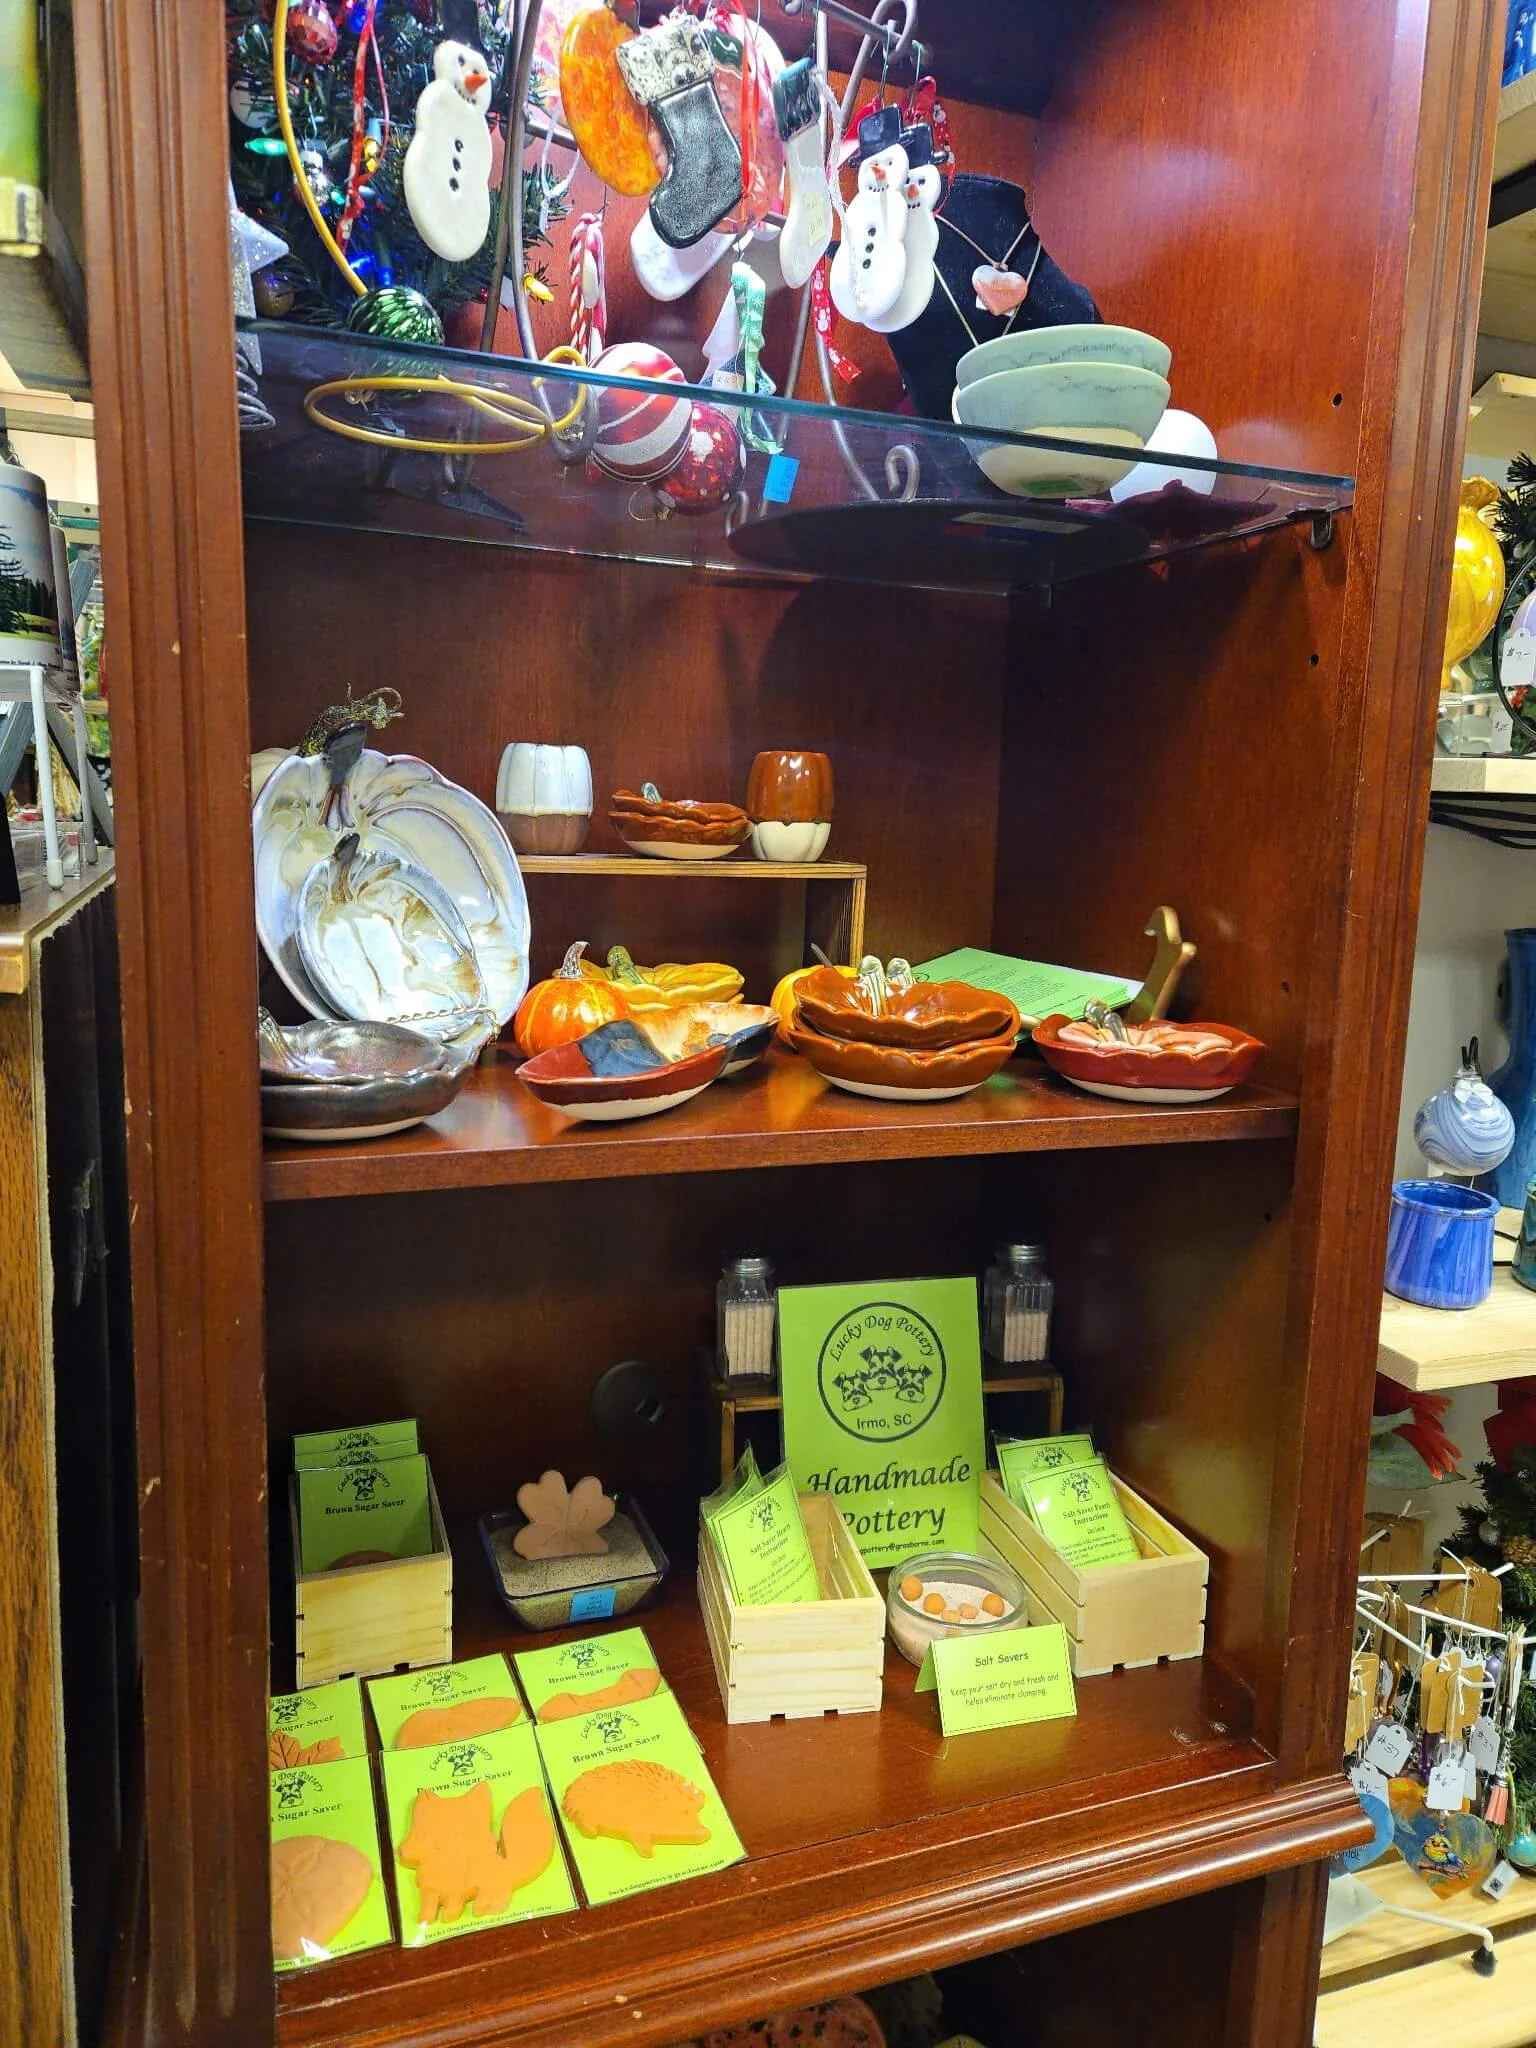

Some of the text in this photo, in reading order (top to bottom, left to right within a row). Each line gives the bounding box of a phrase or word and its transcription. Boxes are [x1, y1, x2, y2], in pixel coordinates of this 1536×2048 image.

[829, 1315, 934, 1363] Lucky Dog Pottery
[857, 1414, 912, 1431] Irmo, SC
[338, 1467, 391, 1492] Lucky Dog Pottery
[807, 1455, 971, 1495] Handmade
[325, 1499, 405, 1514] Brown Sugar Saver
[842, 1507, 946, 1536] Pottery
[975, 1652, 1029, 1667] Salt Savers
[548, 1661, 630, 1685] Brown Sugar Saver
[950, 1688, 967, 1697] Keep
[985, 1683, 998, 1691] salt
[999, 1680, 1012, 1688] dry
[1013, 1677, 1025, 1686] and
[1026, 1674, 1045, 1685] fresh
[1047, 1672, 1059, 1681] and
[400, 1685, 488, 1711] Brown Sugar Saver
[965, 1697, 983, 1706] helps
[985, 1692, 1016, 1703] eliminate
[306, 1715, 334, 1726] Saver
[581, 1710, 640, 1739] Lucky Dog Pottery
[430, 1743, 493, 1771] Lucky Dog Pottery
[572, 1733, 661, 1763] Brown Sugar Saver
[278, 1771, 323, 1792] Dog Pottery
[452, 1777, 481, 1787] Sugar
[484, 1770, 512, 1780] Saver
[278, 1810, 309, 1821] Sugar
[312, 1803, 342, 1815] Saver
